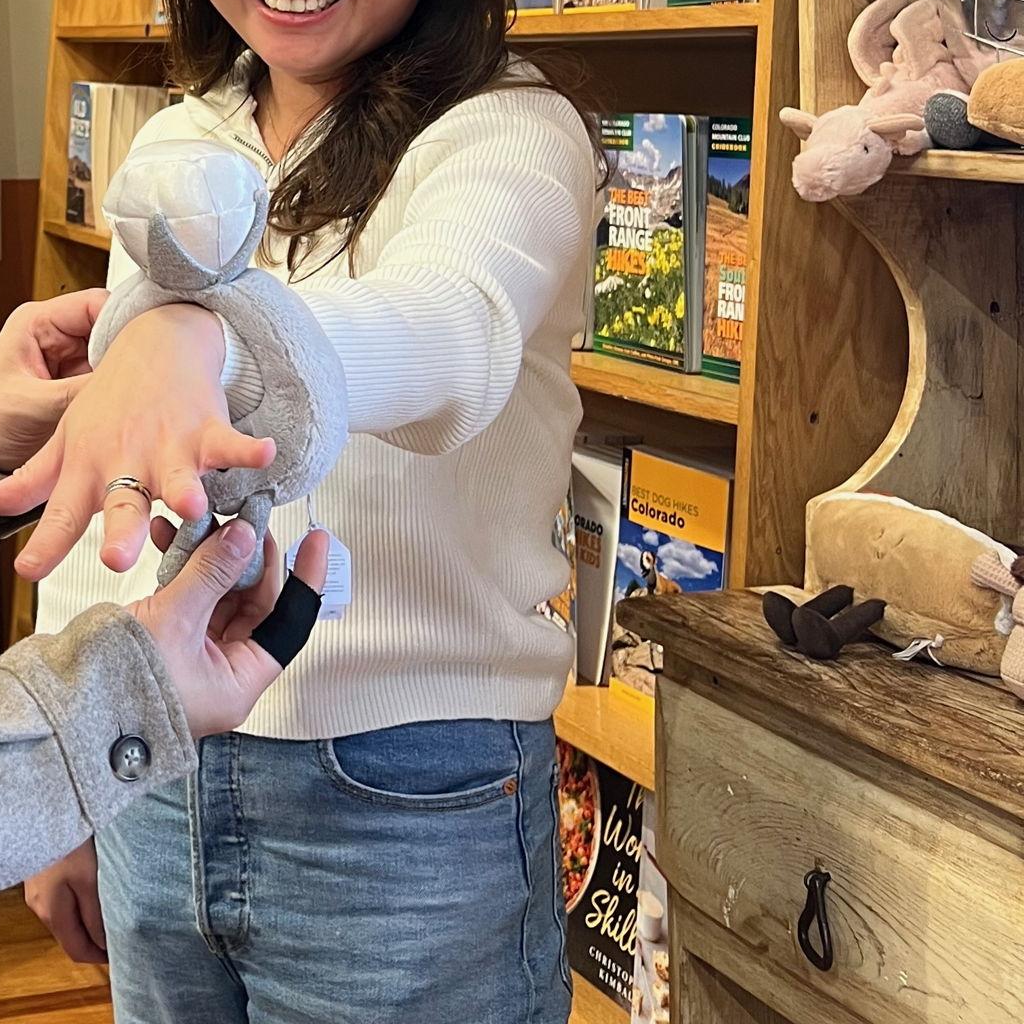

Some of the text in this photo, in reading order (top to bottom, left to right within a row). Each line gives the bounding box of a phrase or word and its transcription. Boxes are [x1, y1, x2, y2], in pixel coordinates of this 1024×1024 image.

[738, 134, 750, 142] CLUB
[608, 188, 650, 207] THE BEST
[608, 204, 651, 229] FRONT
[608, 226, 653, 252] RANGE
[606, 248, 647, 276] HIKES
[719, 252, 734, 266] THE
[717, 299, 744, 321] RAN
[631, 485, 699, 517] BEST DOG HIKES
[631, 498, 685, 528] Colorado
[574, 514, 603, 535] ORADO
[603, 804, 642, 863] Wor
[612, 861, 635, 894] in
[585, 889, 637, 957] Skill
